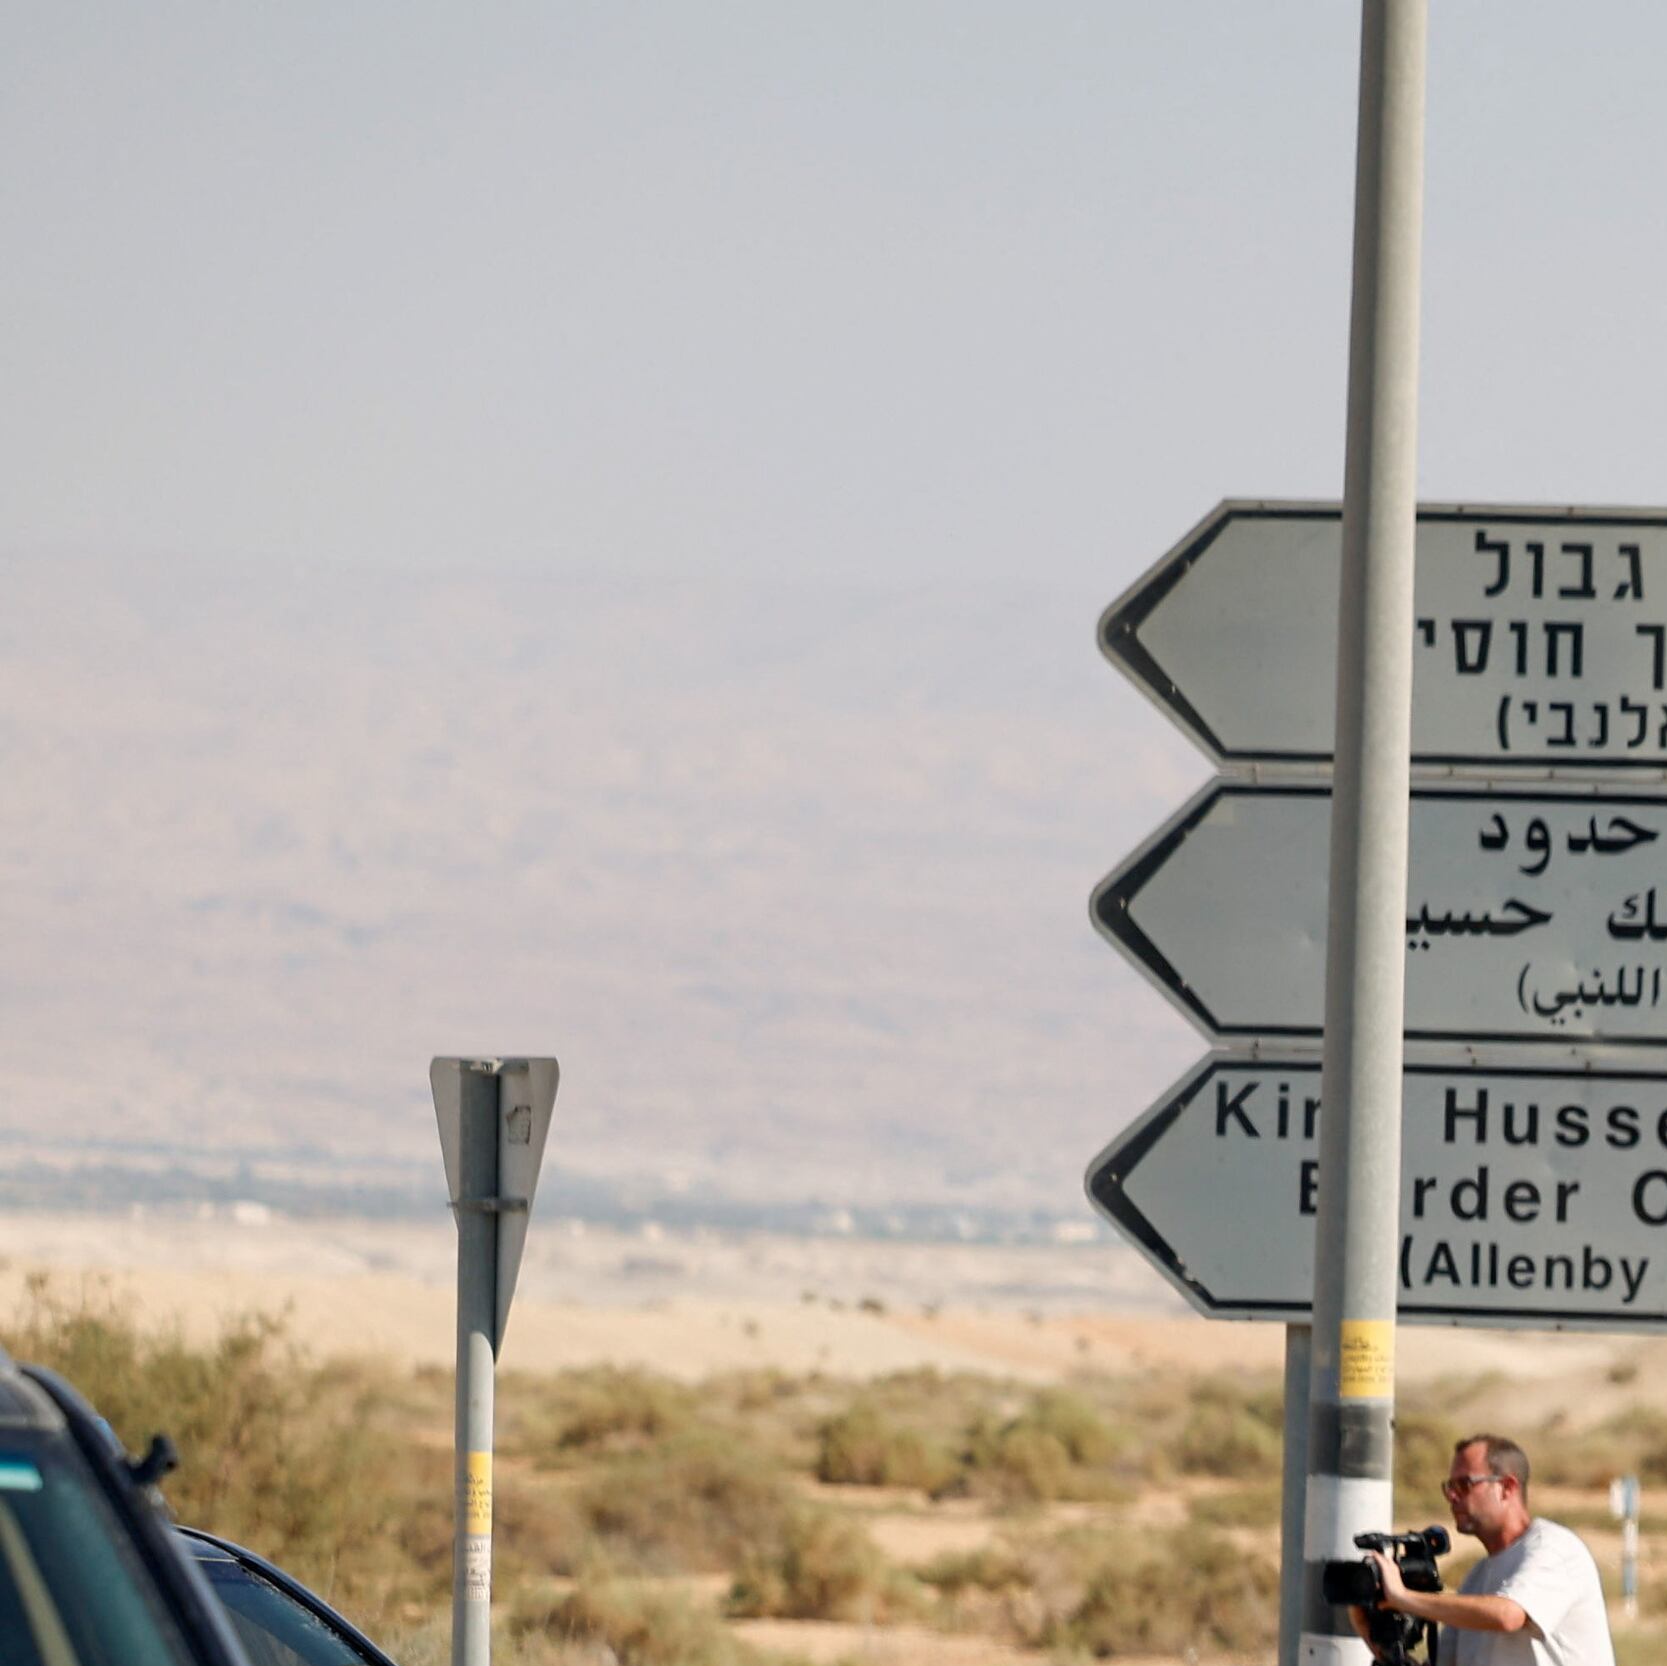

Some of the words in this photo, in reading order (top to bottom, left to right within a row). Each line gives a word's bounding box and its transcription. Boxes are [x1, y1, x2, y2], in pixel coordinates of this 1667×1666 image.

[1474, 530, 1645, 600] גבול
[1416, 618, 1584, 678] חוסי
[1479, 813, 1660, 877] حدود
[1405, 898, 1553, 951] حسي
[1517, 965, 1660, 1017] اللنبي)
[1215, 1081, 1321, 1140] Ki
[1299, 1158, 1580, 1222] rder
[1400, 1234, 1649, 1301] (Allenby
